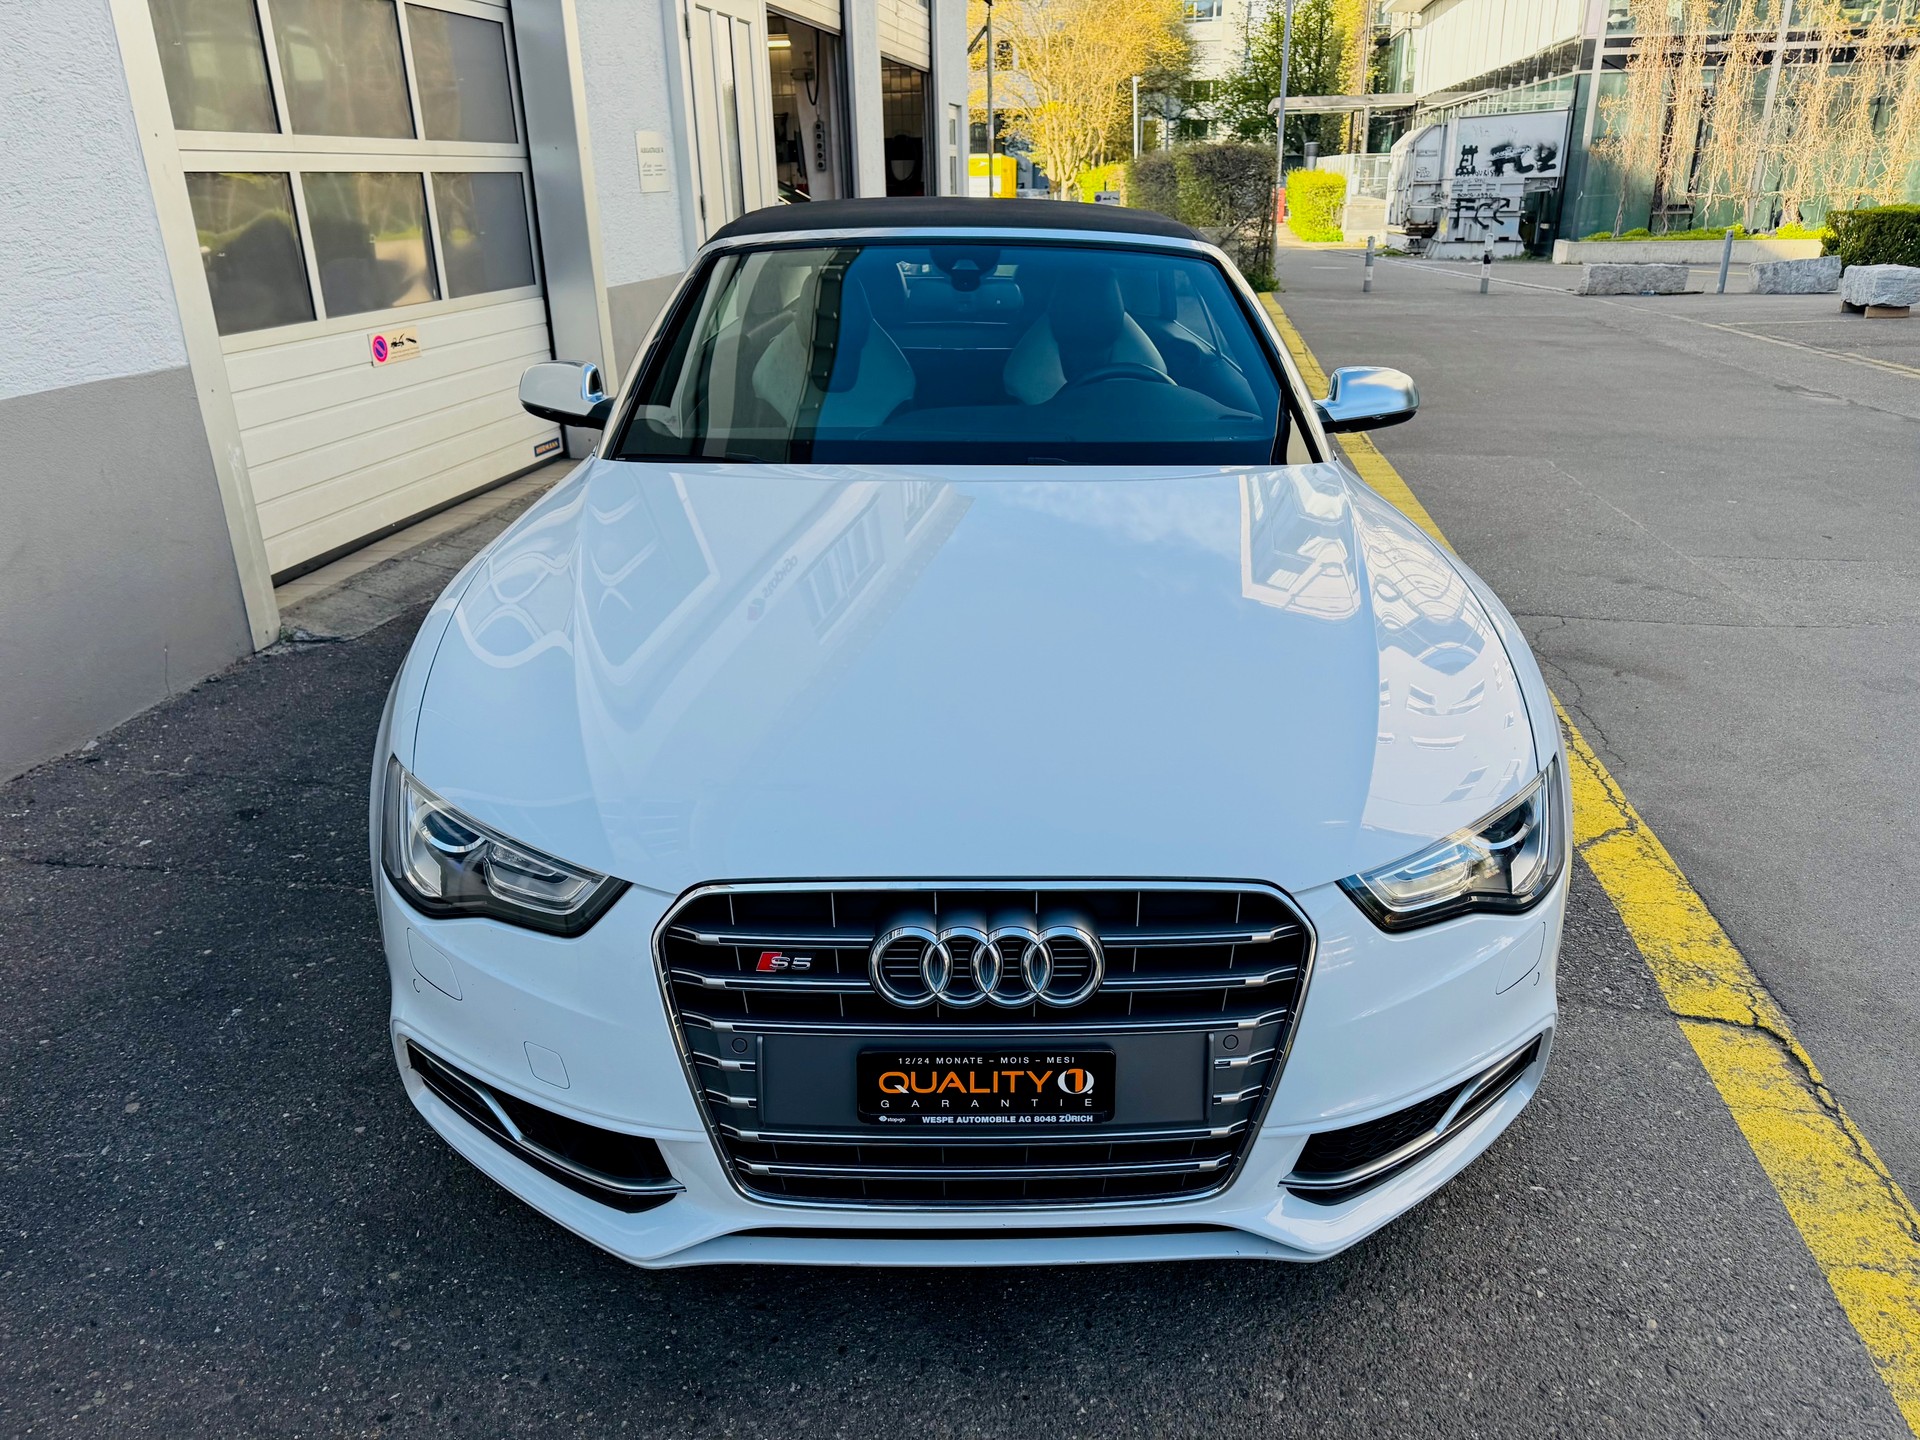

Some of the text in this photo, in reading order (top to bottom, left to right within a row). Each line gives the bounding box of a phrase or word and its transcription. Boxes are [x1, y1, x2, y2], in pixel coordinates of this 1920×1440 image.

[769, 956, 812, 971] S5
[898, 1057, 930, 1065] 12/24
[936, 1057, 983, 1065] MONATE
[1000, 1056, 1030, 1064] MOIS
[1046, 1056, 1075, 1064] MESI
[878, 1070, 1054, 1094] QUALITY
[880, 1098, 1093, 1109] GARANTIE
[921, 1116, 954, 1124] WESPE
[956, 1115, 1017, 1124] AUTOMOBILE
[1018, 1115, 1032, 1123] AG
[1033, 1115, 1057, 1123] 8048
[1058, 1113, 1094, 1123] ZÜRICH
